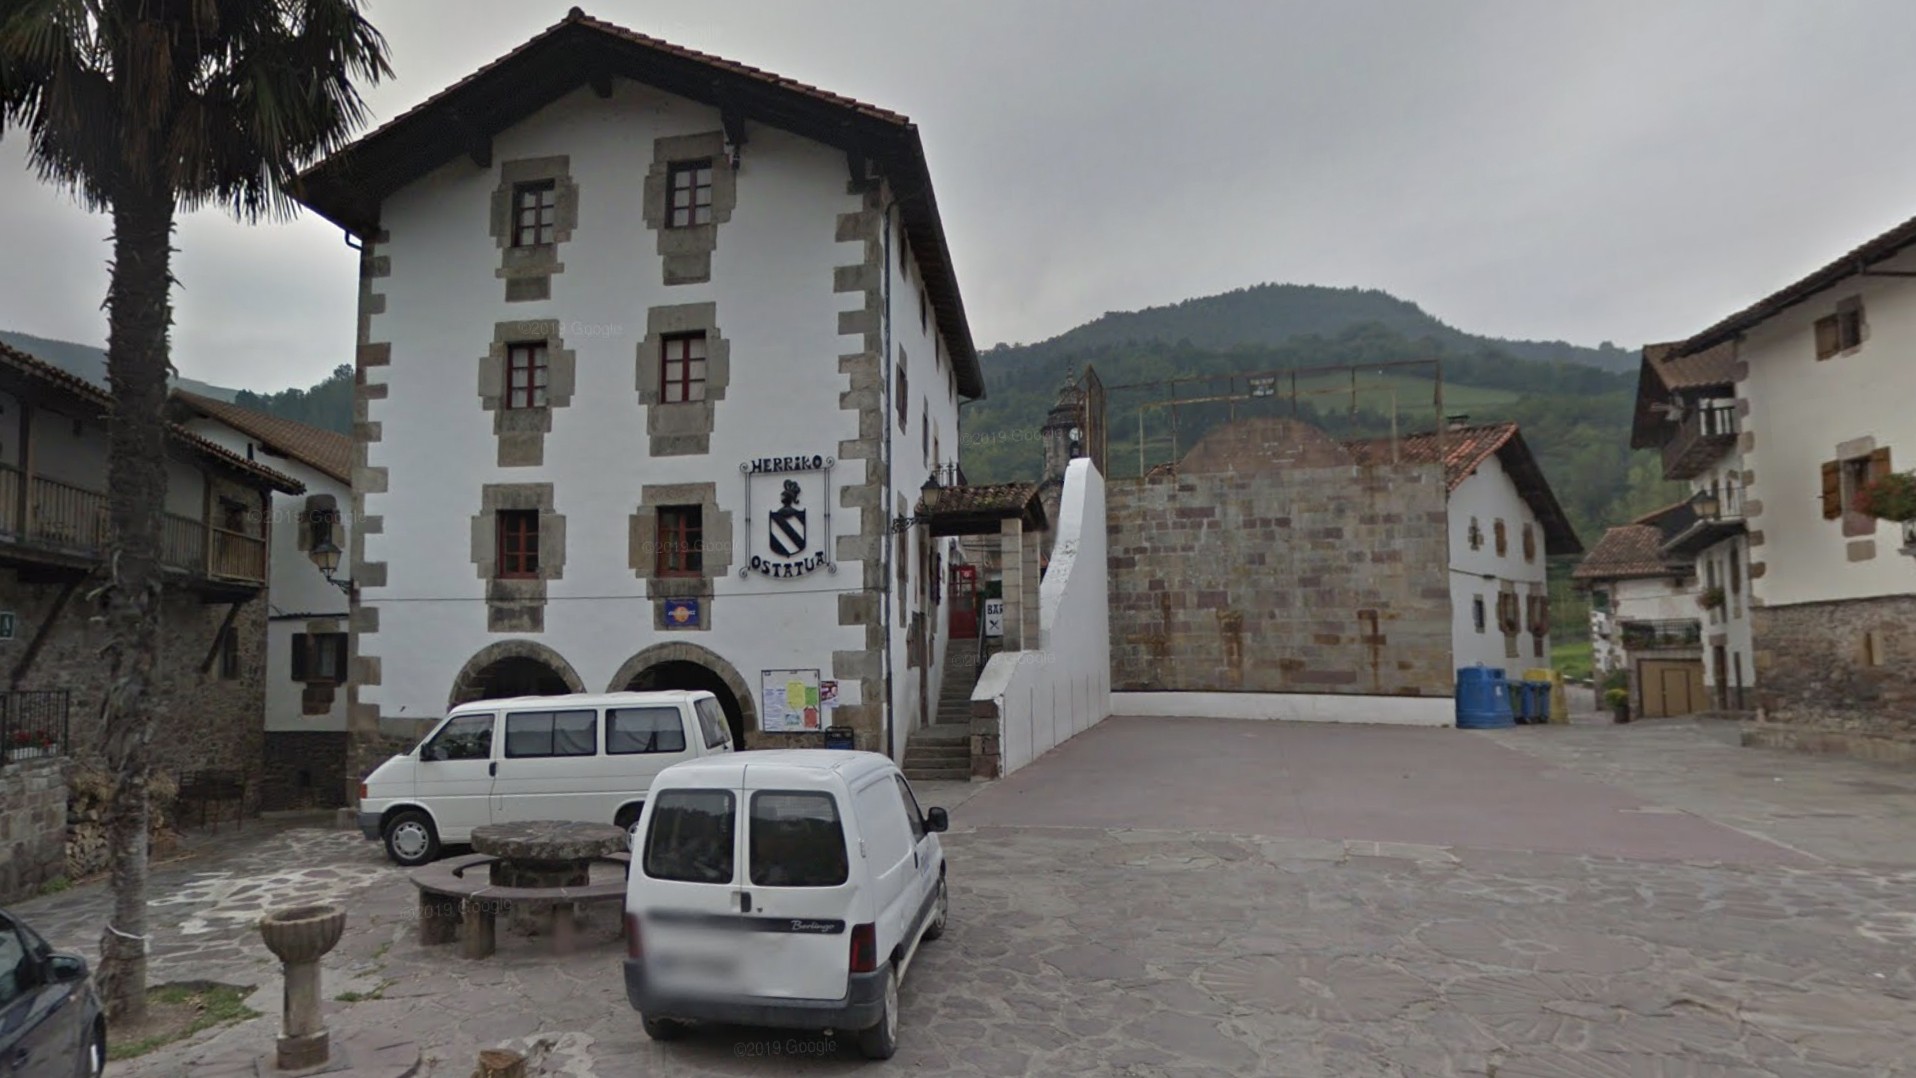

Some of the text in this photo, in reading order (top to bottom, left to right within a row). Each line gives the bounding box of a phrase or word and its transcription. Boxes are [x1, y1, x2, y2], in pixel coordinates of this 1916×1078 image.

[751, 455, 822, 473] HERRIKO
[750, 551, 824, 577] OSTATUA
[790, 920, 835, 932] Berlingo
